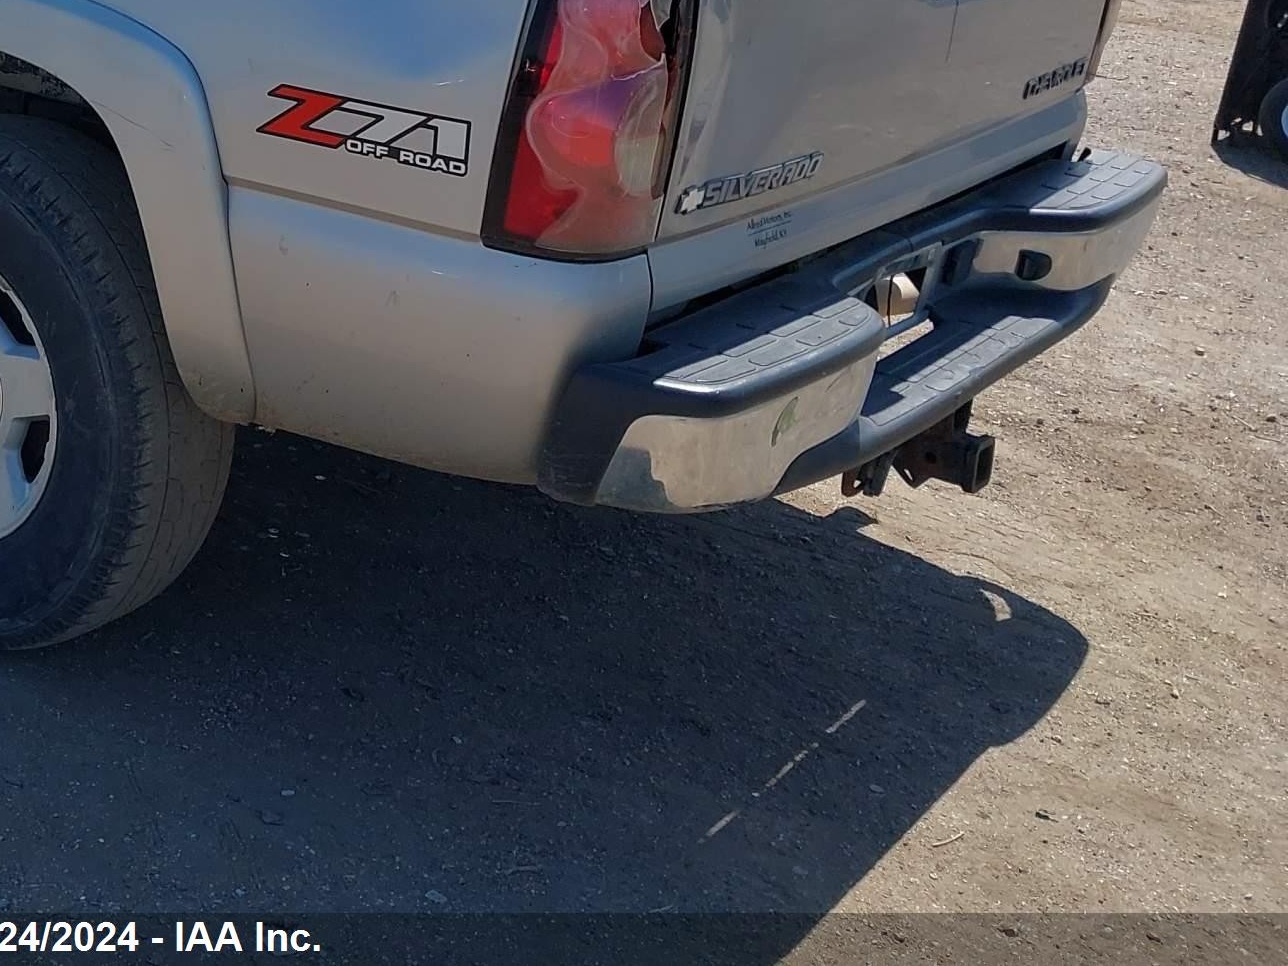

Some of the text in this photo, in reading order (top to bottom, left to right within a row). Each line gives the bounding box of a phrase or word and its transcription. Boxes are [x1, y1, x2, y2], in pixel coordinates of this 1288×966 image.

[256, 83, 472, 166] Z71
[344, 138, 467, 175] OFF ROAD
[703, 151, 825, 207] SILVERADO
